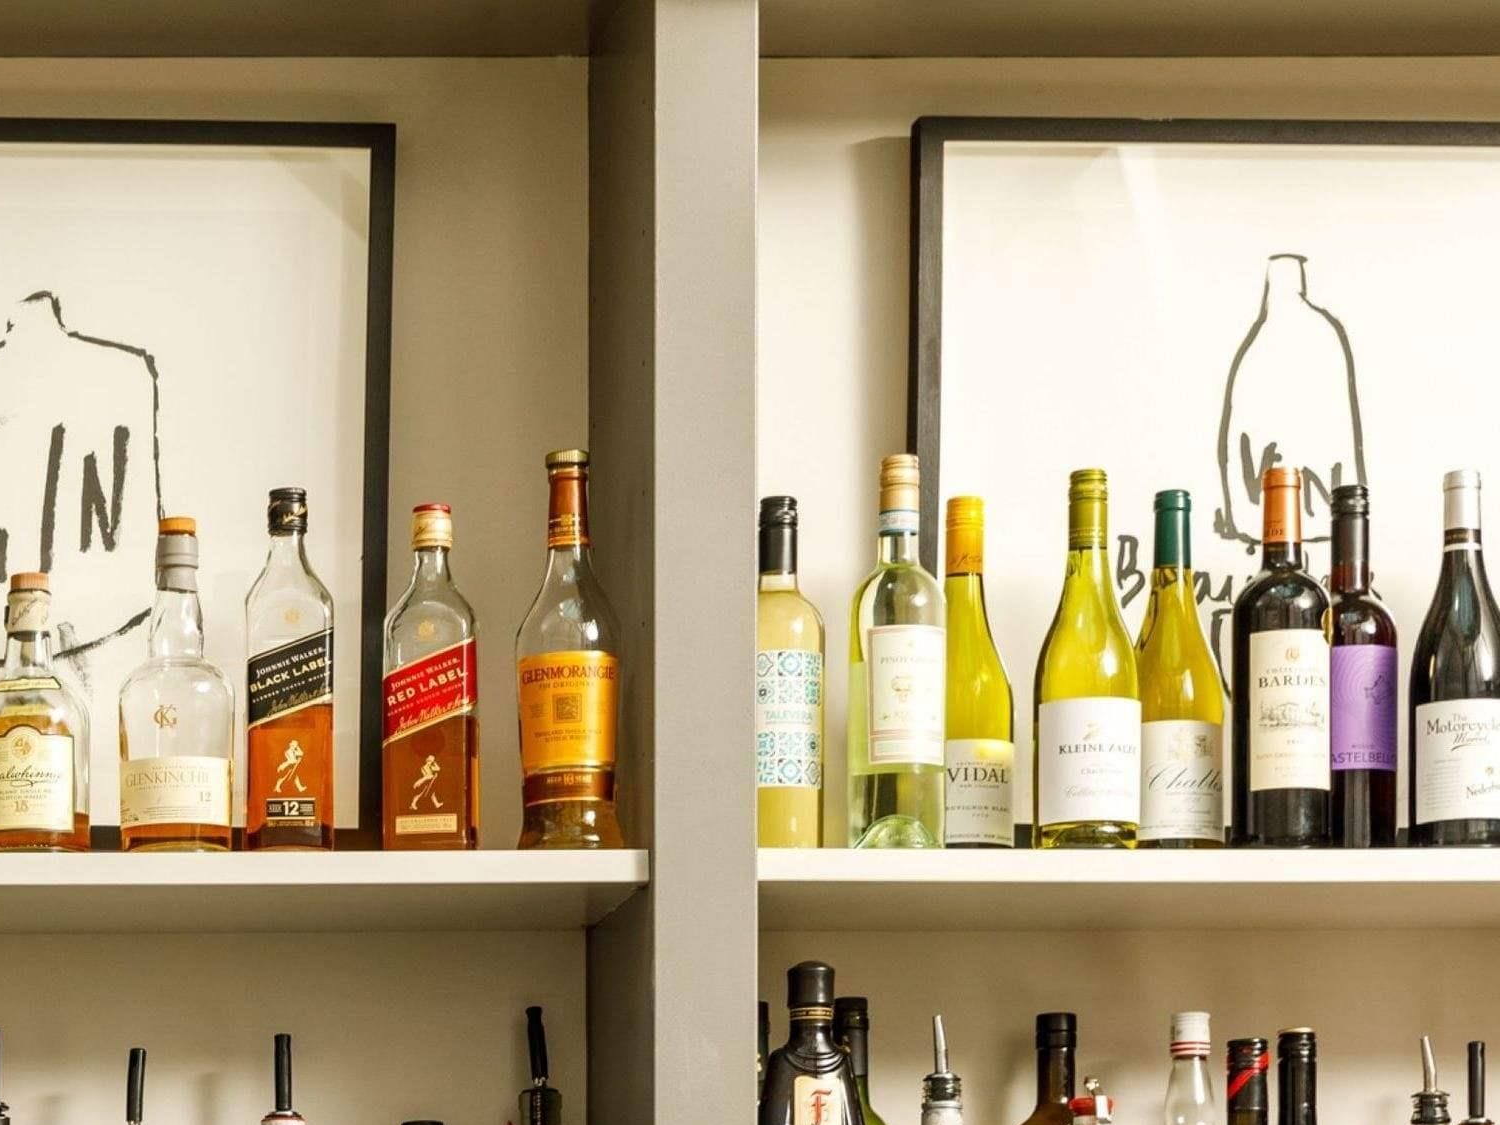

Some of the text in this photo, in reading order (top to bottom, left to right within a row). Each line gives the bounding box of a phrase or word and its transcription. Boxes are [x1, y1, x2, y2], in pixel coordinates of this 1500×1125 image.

[250, 657, 332, 693] BLACK LABEL
[256, 657, 288, 678] JOHNNIE
[521, 663, 614, 686] GLENMORANGIE
[386, 686, 416, 707] RED
[419, 670, 469, 694] LABEL
[391, 668, 423, 690] JOHNNIE
[1059, 742, 1104, 755] KLEINE
[947, 766, 1009, 785] VIDAL
[282, 801, 300, 816] 12
